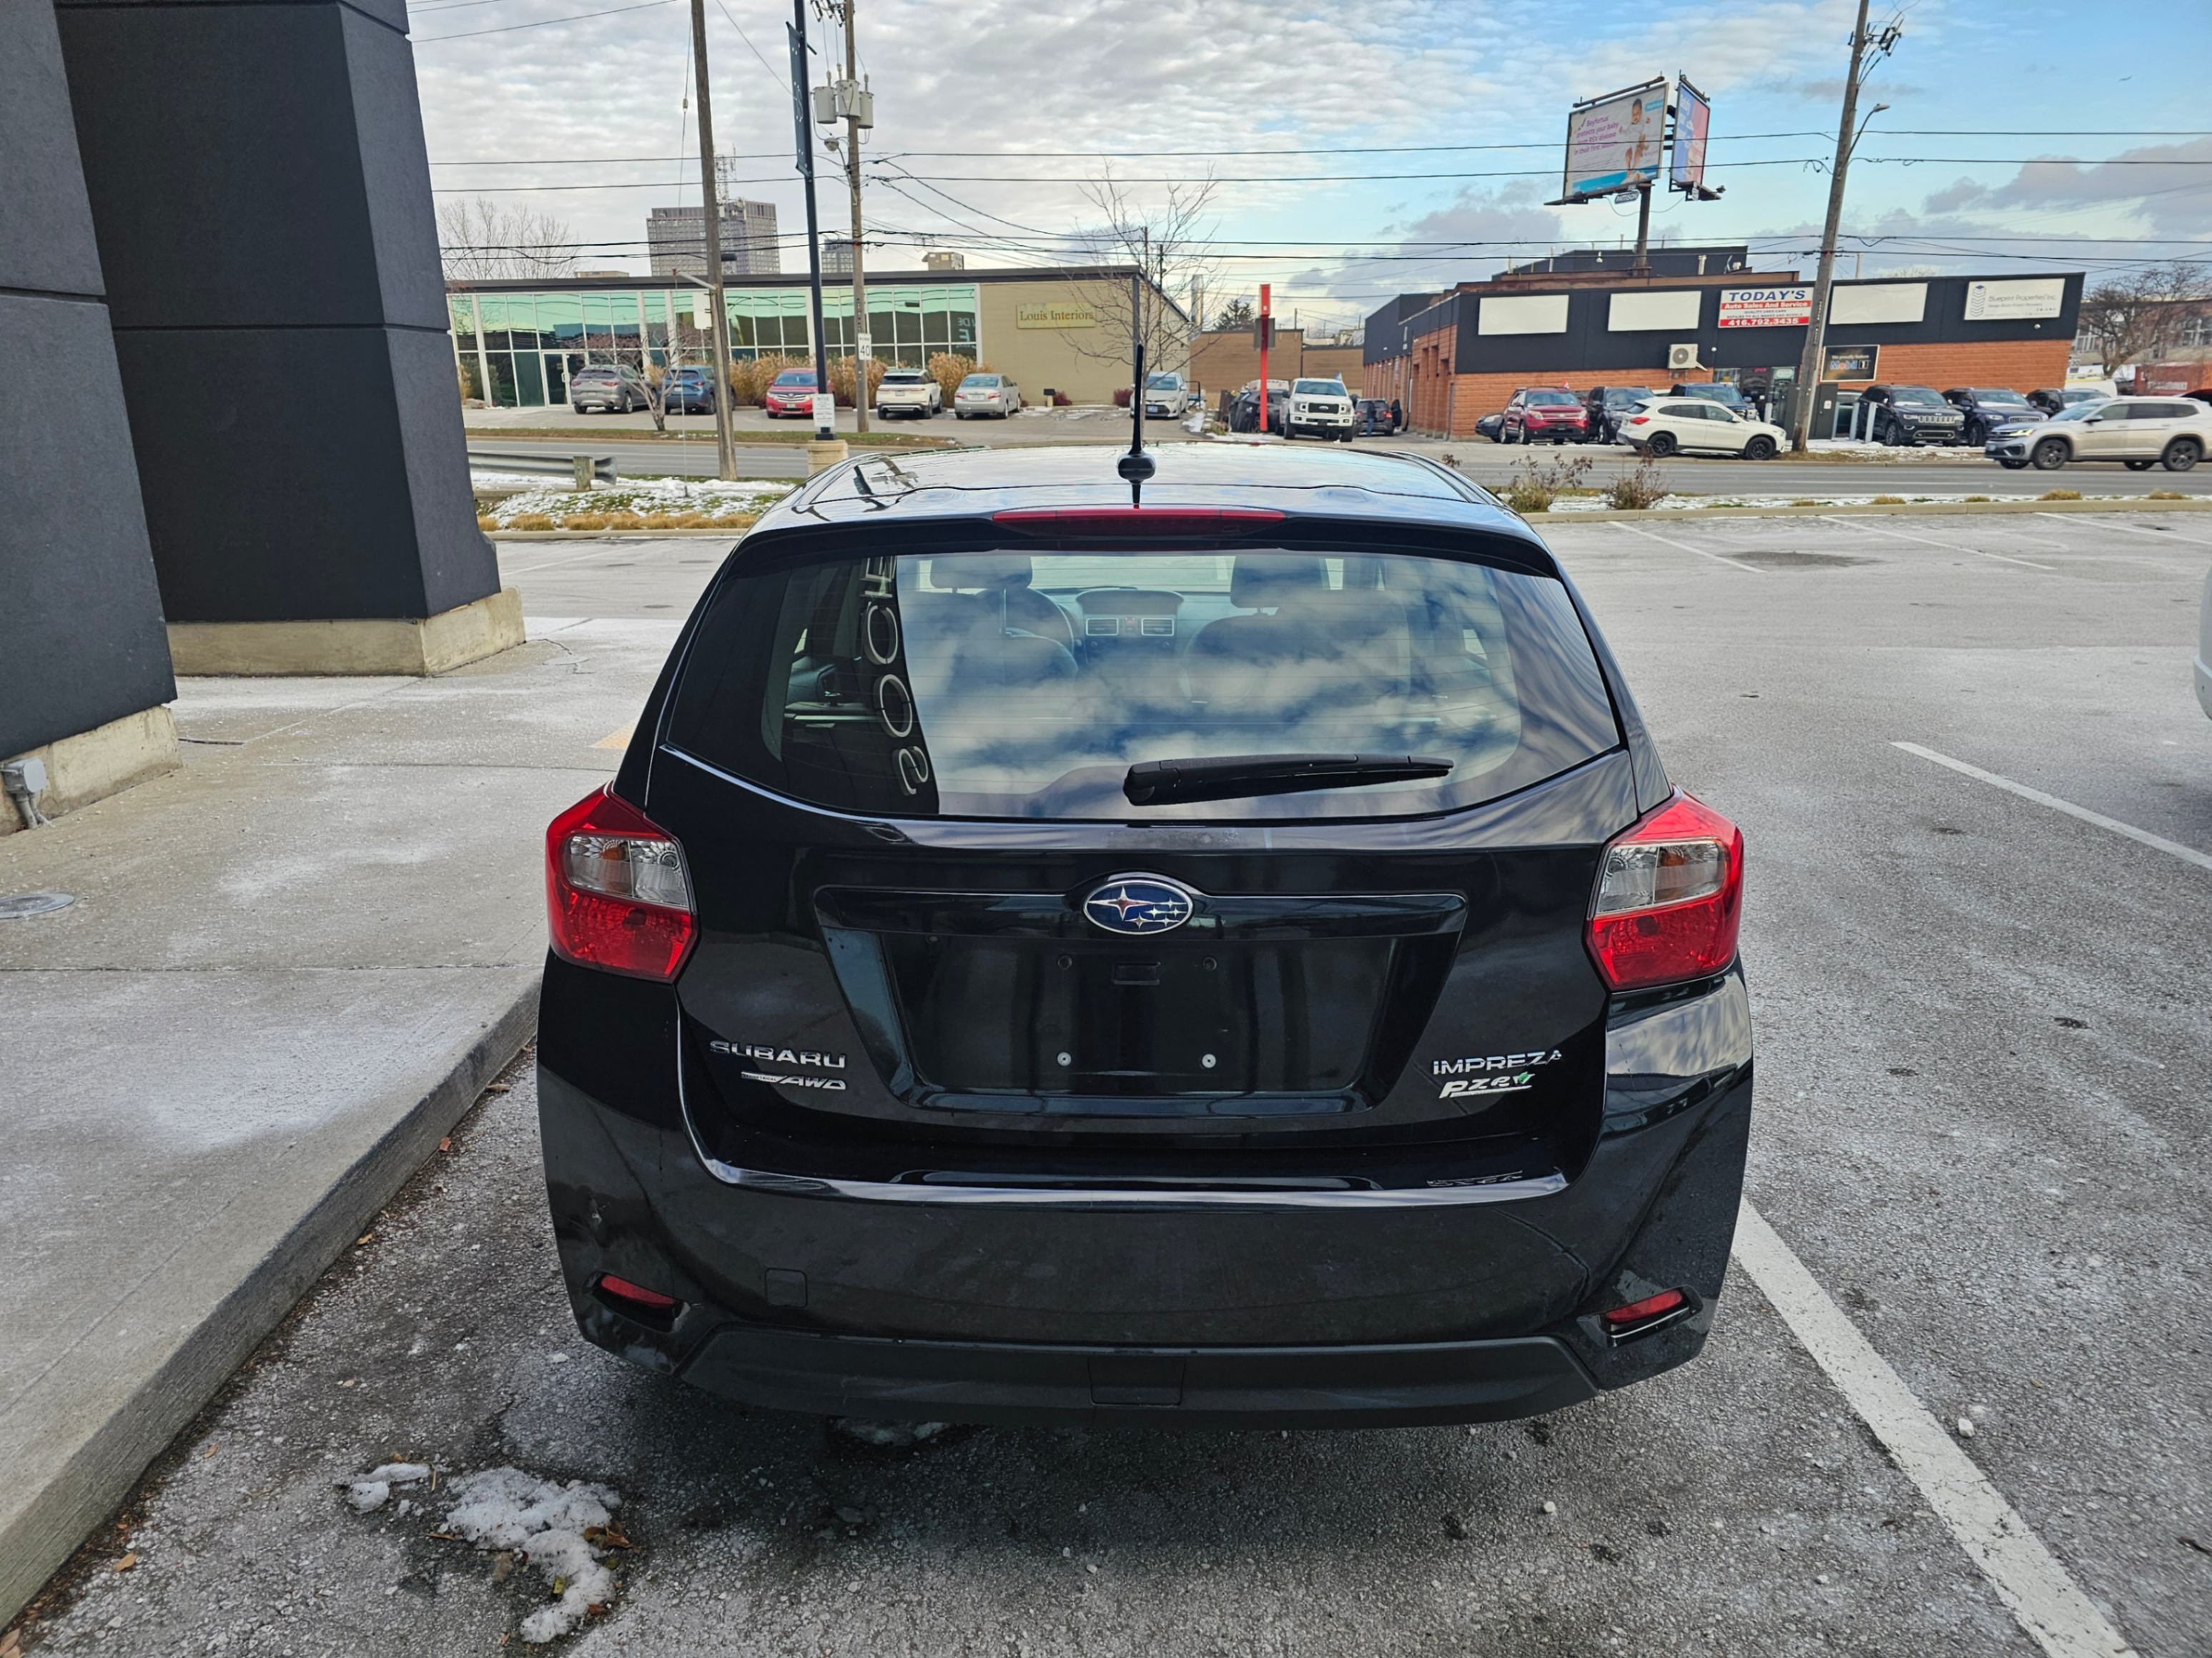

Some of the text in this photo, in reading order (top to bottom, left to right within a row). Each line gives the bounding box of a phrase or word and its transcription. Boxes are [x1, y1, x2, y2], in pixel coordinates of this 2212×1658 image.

[1729, 290, 1805, 301] TODAY'S
[1020, 310, 1094, 321] Louis Interiors
[860, 345, 871, 356] 40
[1830, 360, 1858, 370] Mobil
[709, 1040, 846, 1069] SUBARU
[1433, 1049, 1563, 1075] IMPREZA
[779, 1075, 846, 1091] AWD
